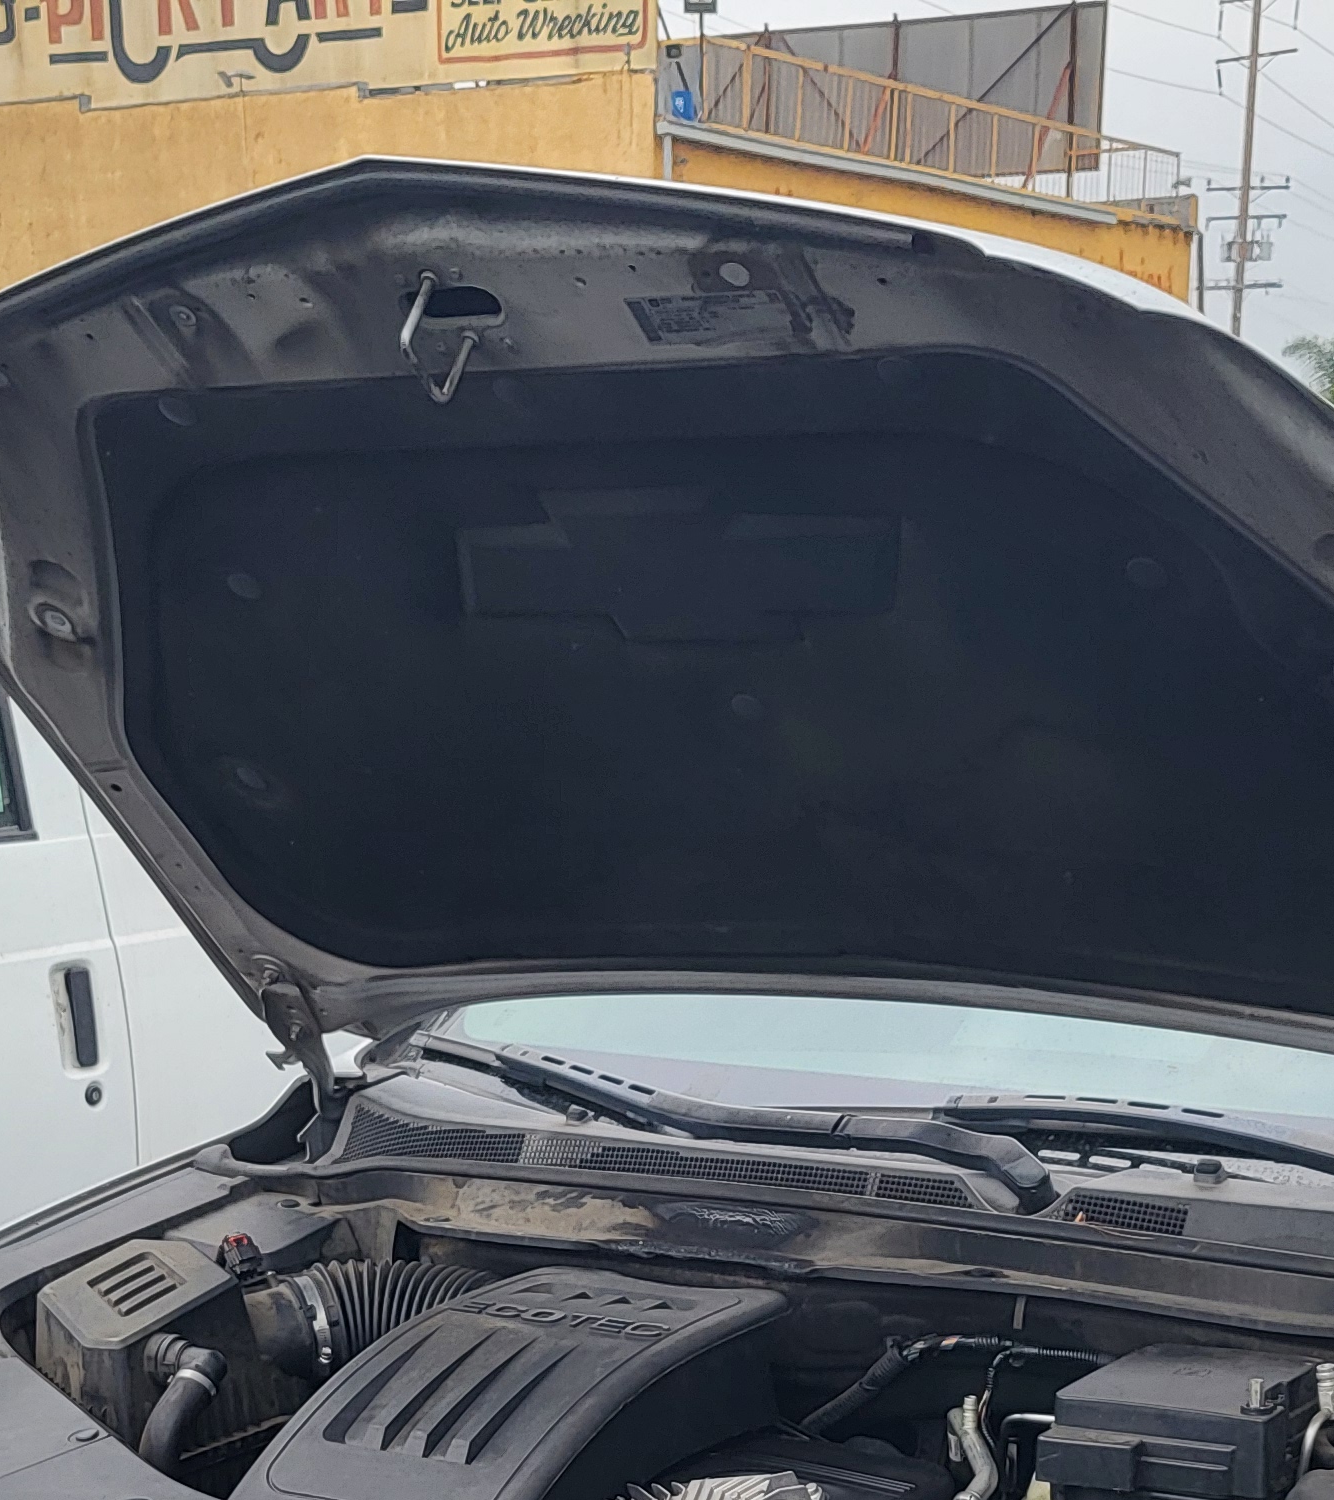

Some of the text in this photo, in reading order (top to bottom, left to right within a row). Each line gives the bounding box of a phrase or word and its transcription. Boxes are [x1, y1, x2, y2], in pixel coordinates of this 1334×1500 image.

[444, 10, 513, 54] Auto
[516, 3, 641, 42] Wrecking
[449, 1300, 671, 1338] ECOTEC
